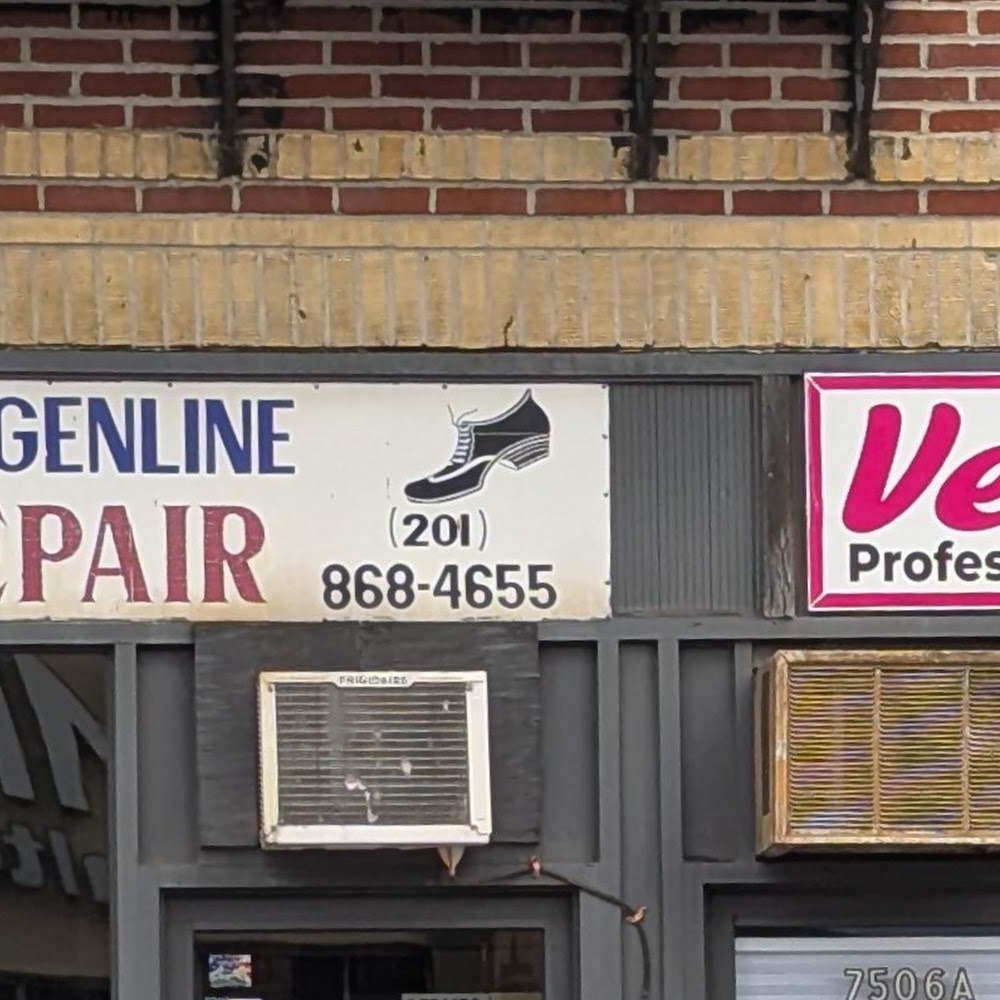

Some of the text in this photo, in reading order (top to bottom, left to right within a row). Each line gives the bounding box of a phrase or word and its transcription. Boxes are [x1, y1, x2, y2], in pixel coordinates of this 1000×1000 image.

[842, 402, 1000, 533] Ve
[390, 506, 487, 551] (201)
[849, 540, 1000, 582] Profes
[322, 563, 557, 610] 868-4655
